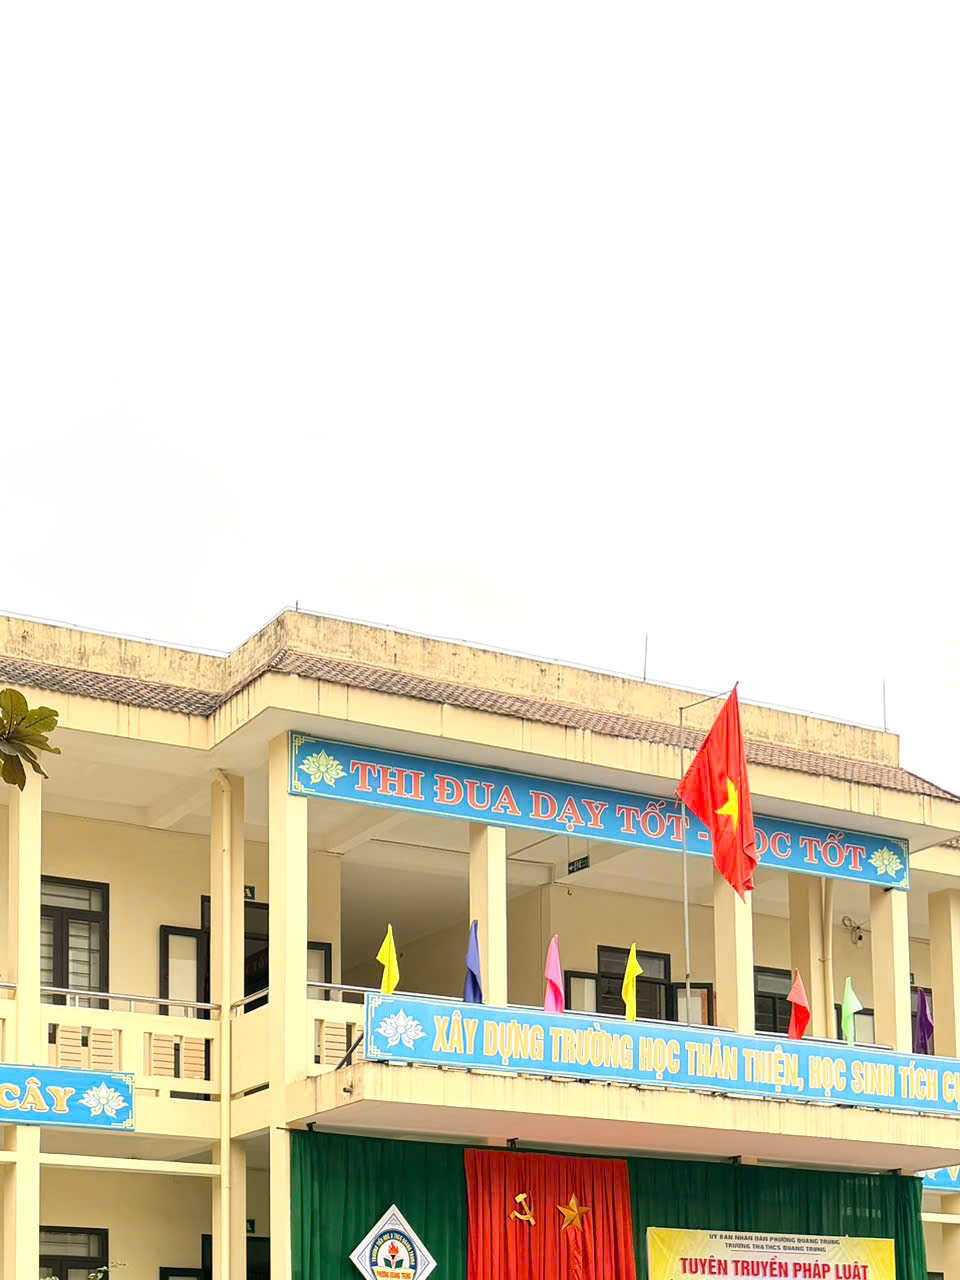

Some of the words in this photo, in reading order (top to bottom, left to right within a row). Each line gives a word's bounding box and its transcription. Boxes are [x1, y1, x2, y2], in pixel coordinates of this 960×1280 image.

[349, 760, 425, 801] THI
[433, 774, 522, 816] ĐUA
[529, 790, 609, 832] DẠY
[615, 800, 689, 842] TỐT
[751, 828, 792, 863] ỌC
[799, 832, 867, 871] TỐT
[432, 1010, 479, 1055] XÂY
[483, 1019, 544, 1065] DỰNG
[550, 1022, 634, 1070] TRƯỜNG
[639, 1036, 681, 1080] HỌC
[685, 1037, 738, 1081] THÂN
[742, 1045, 805, 1092] THIỆN,
[809, 1055, 847, 1097] HỌC
[851, 1061, 895, 1099] SINH
[899, 1060, 939, 1101] TÍCH
[679, 1255, 728, 1276] TUYÊN
[731, 1255, 788, 1278] TRUYỀN
[792, 1259, 831, 1280] PHÁP
